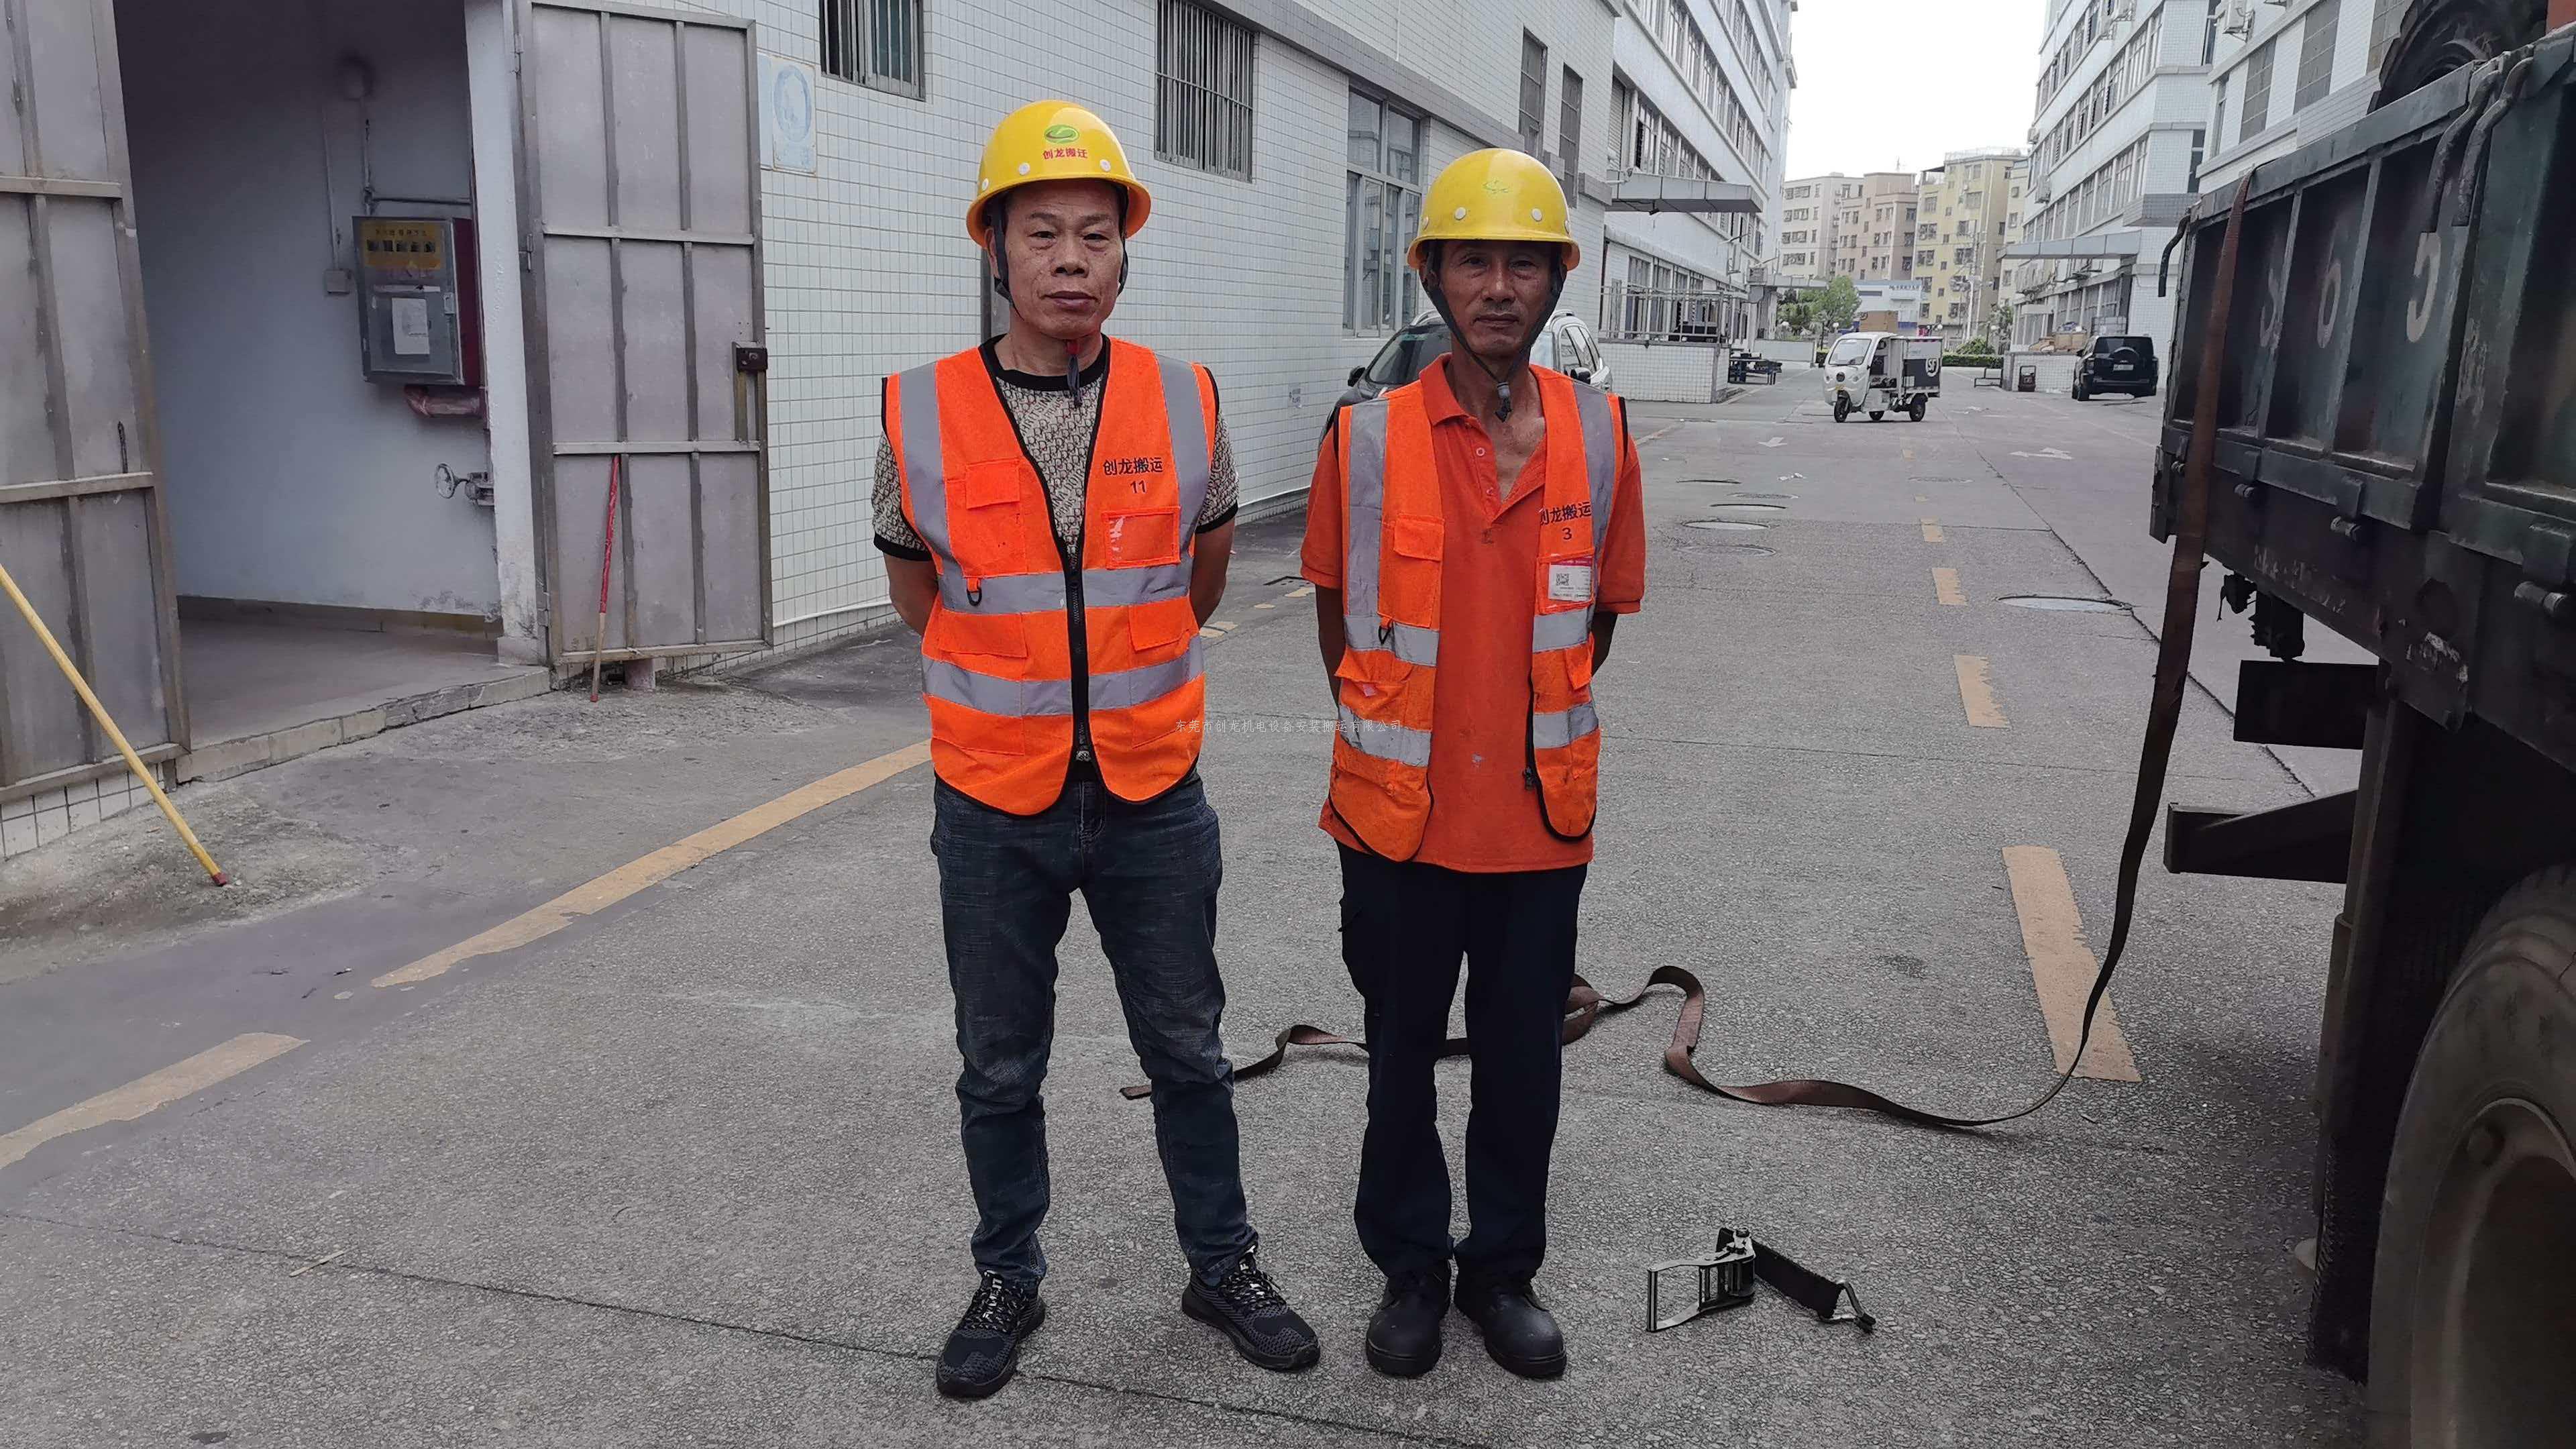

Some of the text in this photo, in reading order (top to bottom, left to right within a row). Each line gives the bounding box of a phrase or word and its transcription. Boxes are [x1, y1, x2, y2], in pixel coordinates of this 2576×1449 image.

[1043, 148, 1088, 160] 创龙搬迁
[1103, 457, 1163, 476] 创龙搬运
[1130, 480, 1147, 494] 11
[1562, 527, 1572, 540] 3
